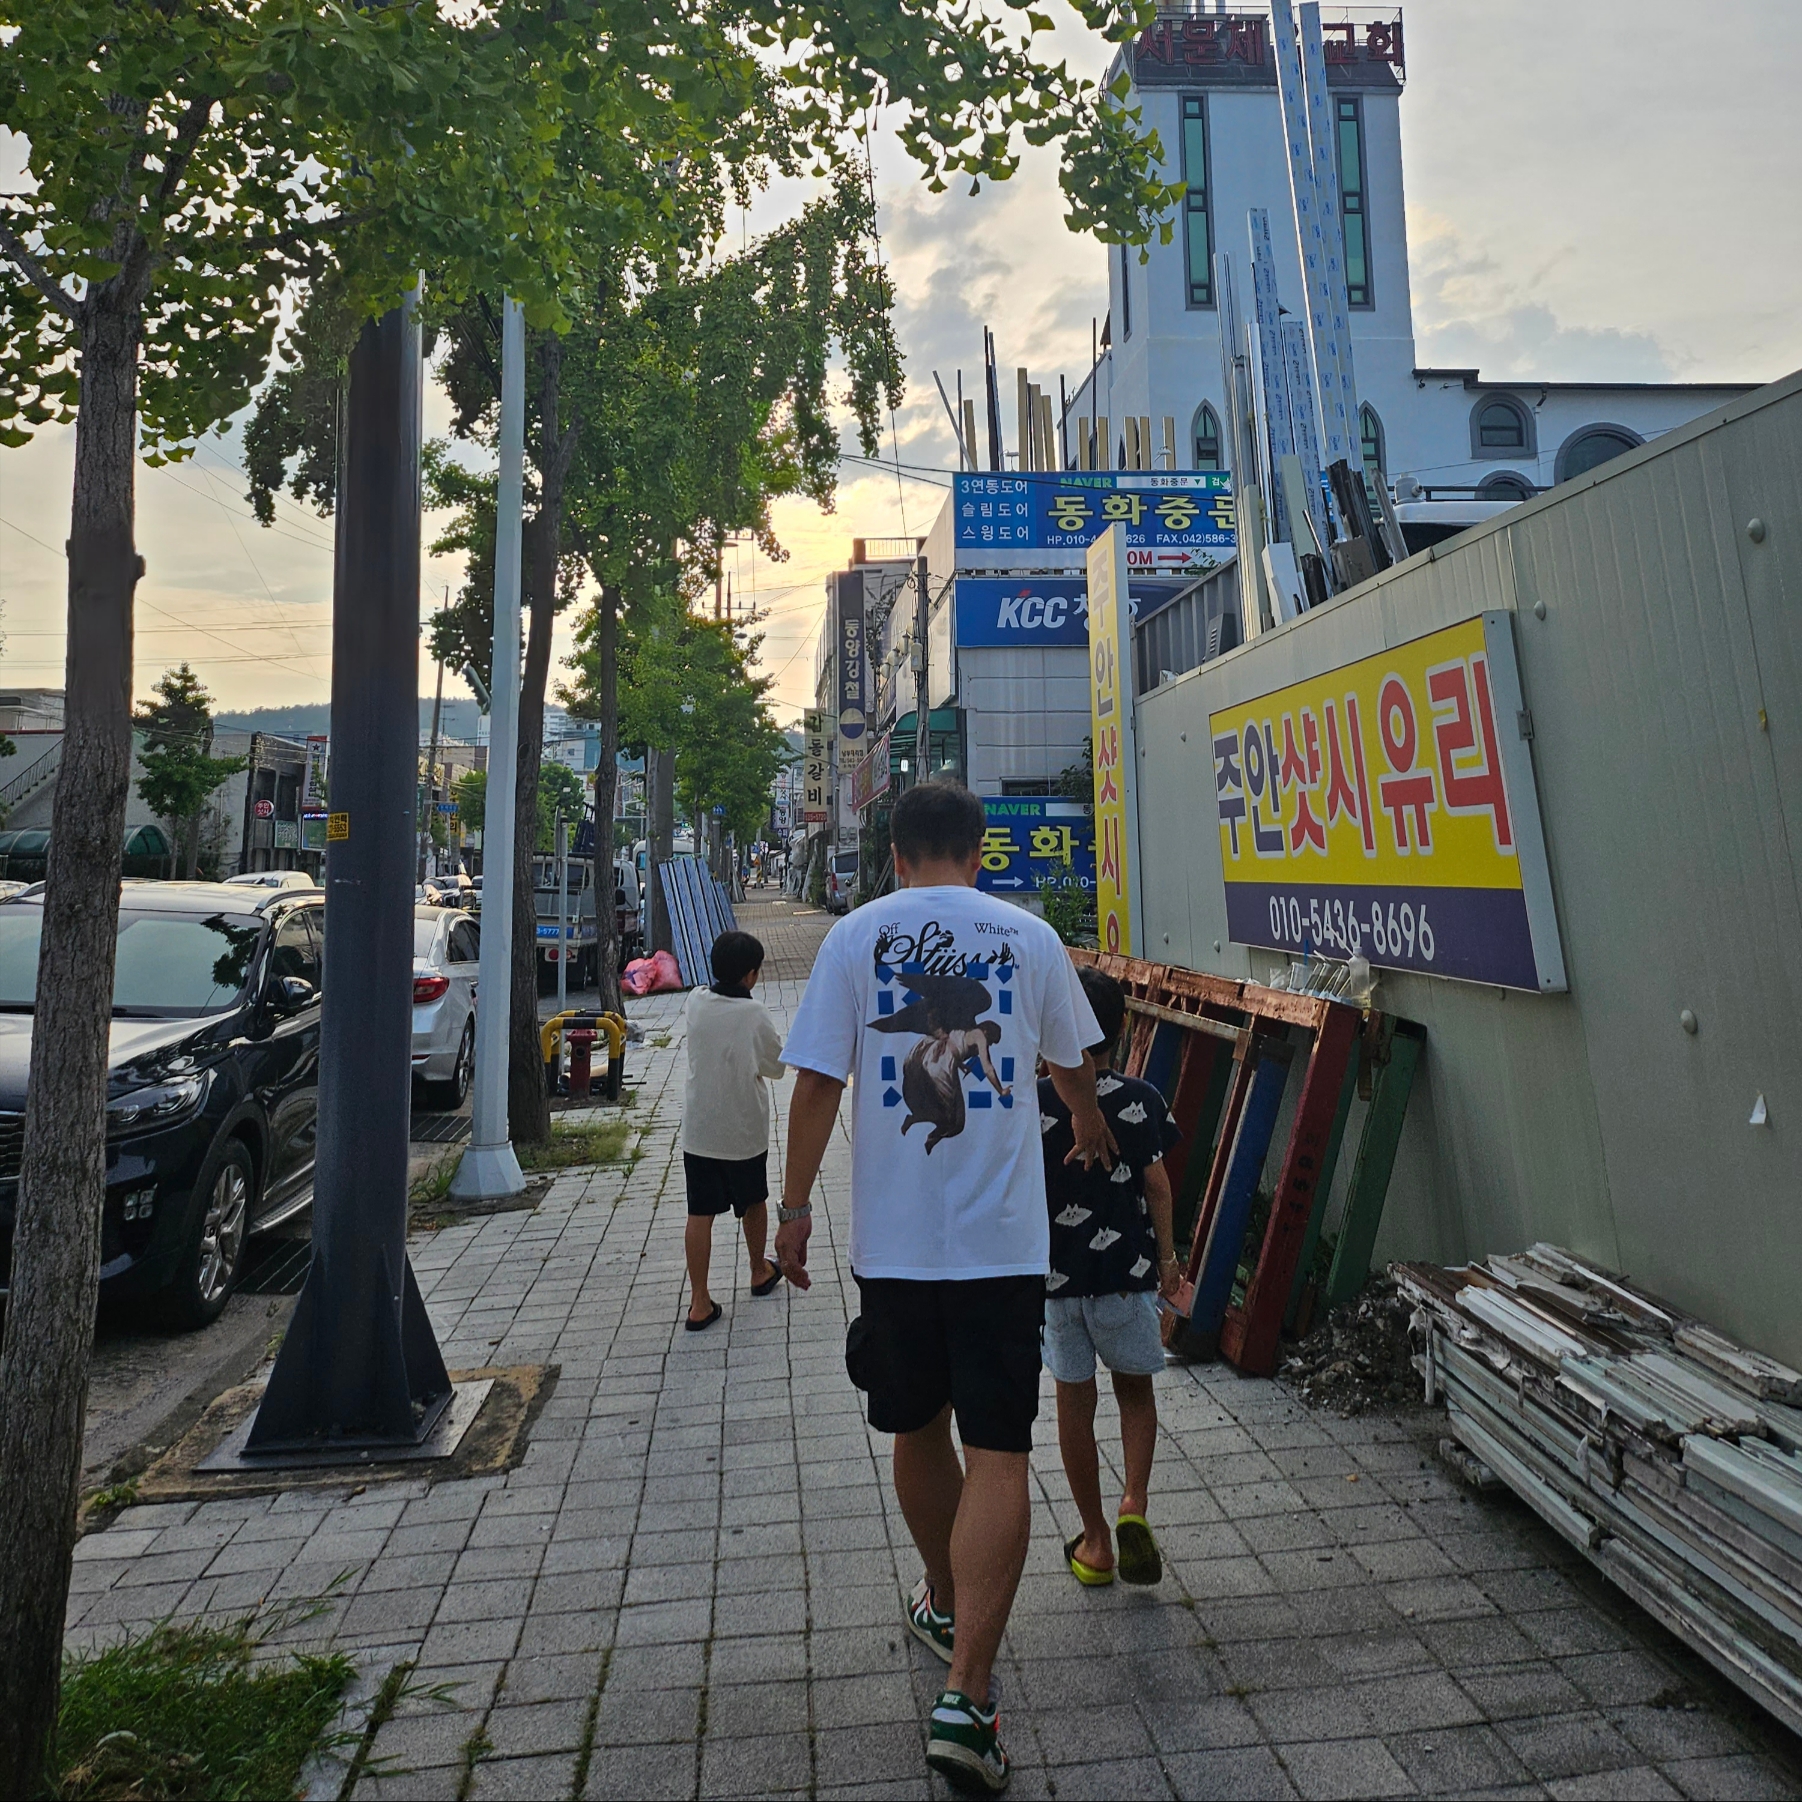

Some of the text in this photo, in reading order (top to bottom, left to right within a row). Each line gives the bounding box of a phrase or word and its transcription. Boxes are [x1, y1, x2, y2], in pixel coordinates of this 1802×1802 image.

[1136, 19, 1402, 66] 서문제교회
[961, 478, 1028, 494] 3연동도어
[1060, 477, 1112, 488] NAVER
[1150, 477, 1188, 486] 동화중문
[997, 590, 1068, 628] KCC
[844, 619, 861, 700] 동양강철
[985, 803, 1041, 815] NAVER
[981, 826, 1097, 871] 동화
[878, 921, 901, 935] Off
[1269, 895, 1435, 962] 010-5436-8696
